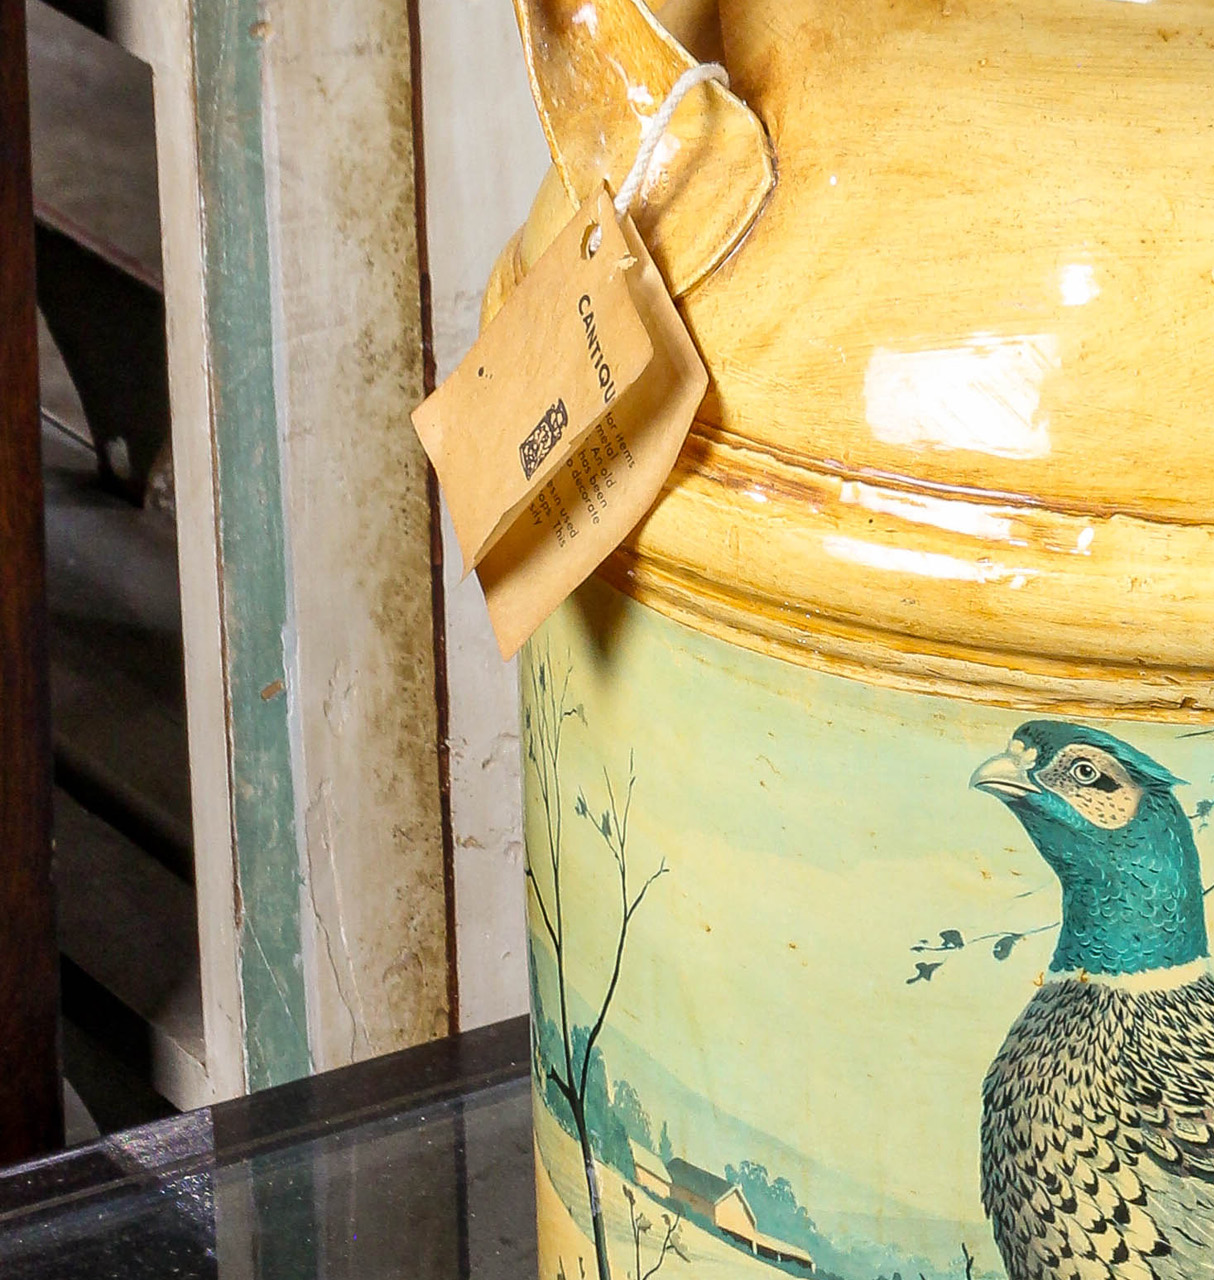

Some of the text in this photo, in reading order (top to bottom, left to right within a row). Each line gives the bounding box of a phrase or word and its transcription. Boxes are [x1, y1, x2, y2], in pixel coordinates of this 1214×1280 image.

[595, 423, 619, 460] metal
[616, 434, 636, 469] items
[590, 474, 608, 509] been
[601, 468, 617, 489] old
[571, 470, 600, 525] decorate
[552, 521, 567, 548] This
[560, 508, 579, 539] used
